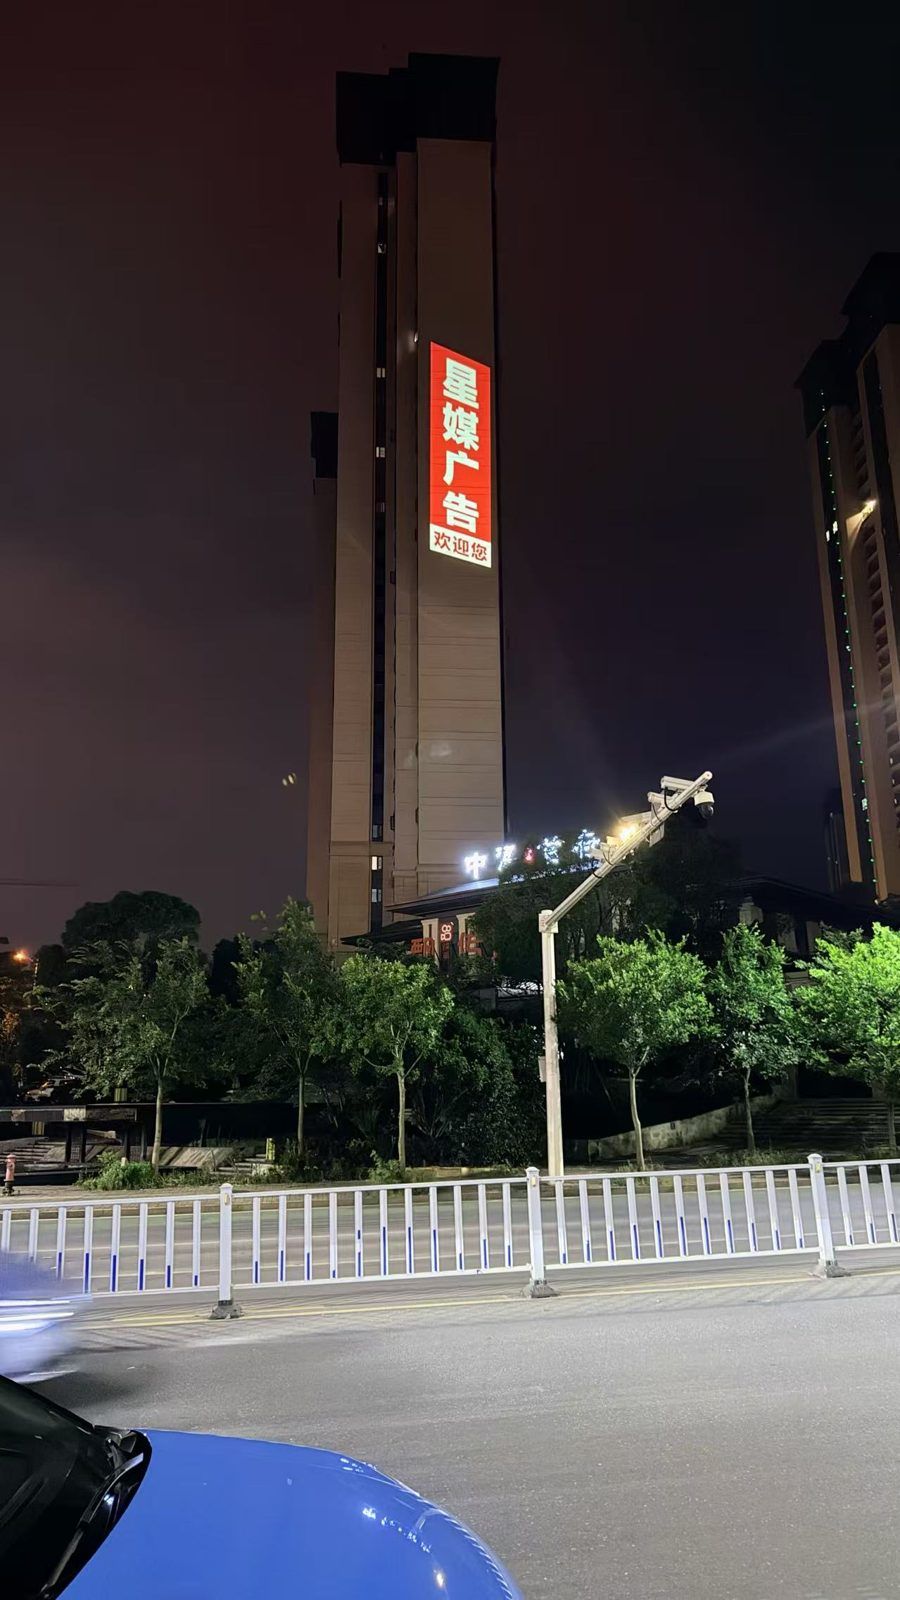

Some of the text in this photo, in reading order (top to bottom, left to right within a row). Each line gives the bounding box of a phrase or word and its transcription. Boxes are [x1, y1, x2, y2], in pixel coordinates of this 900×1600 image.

[442, 357, 480, 534] 星媒广告
[433, 530, 488, 562] 欢迎您
